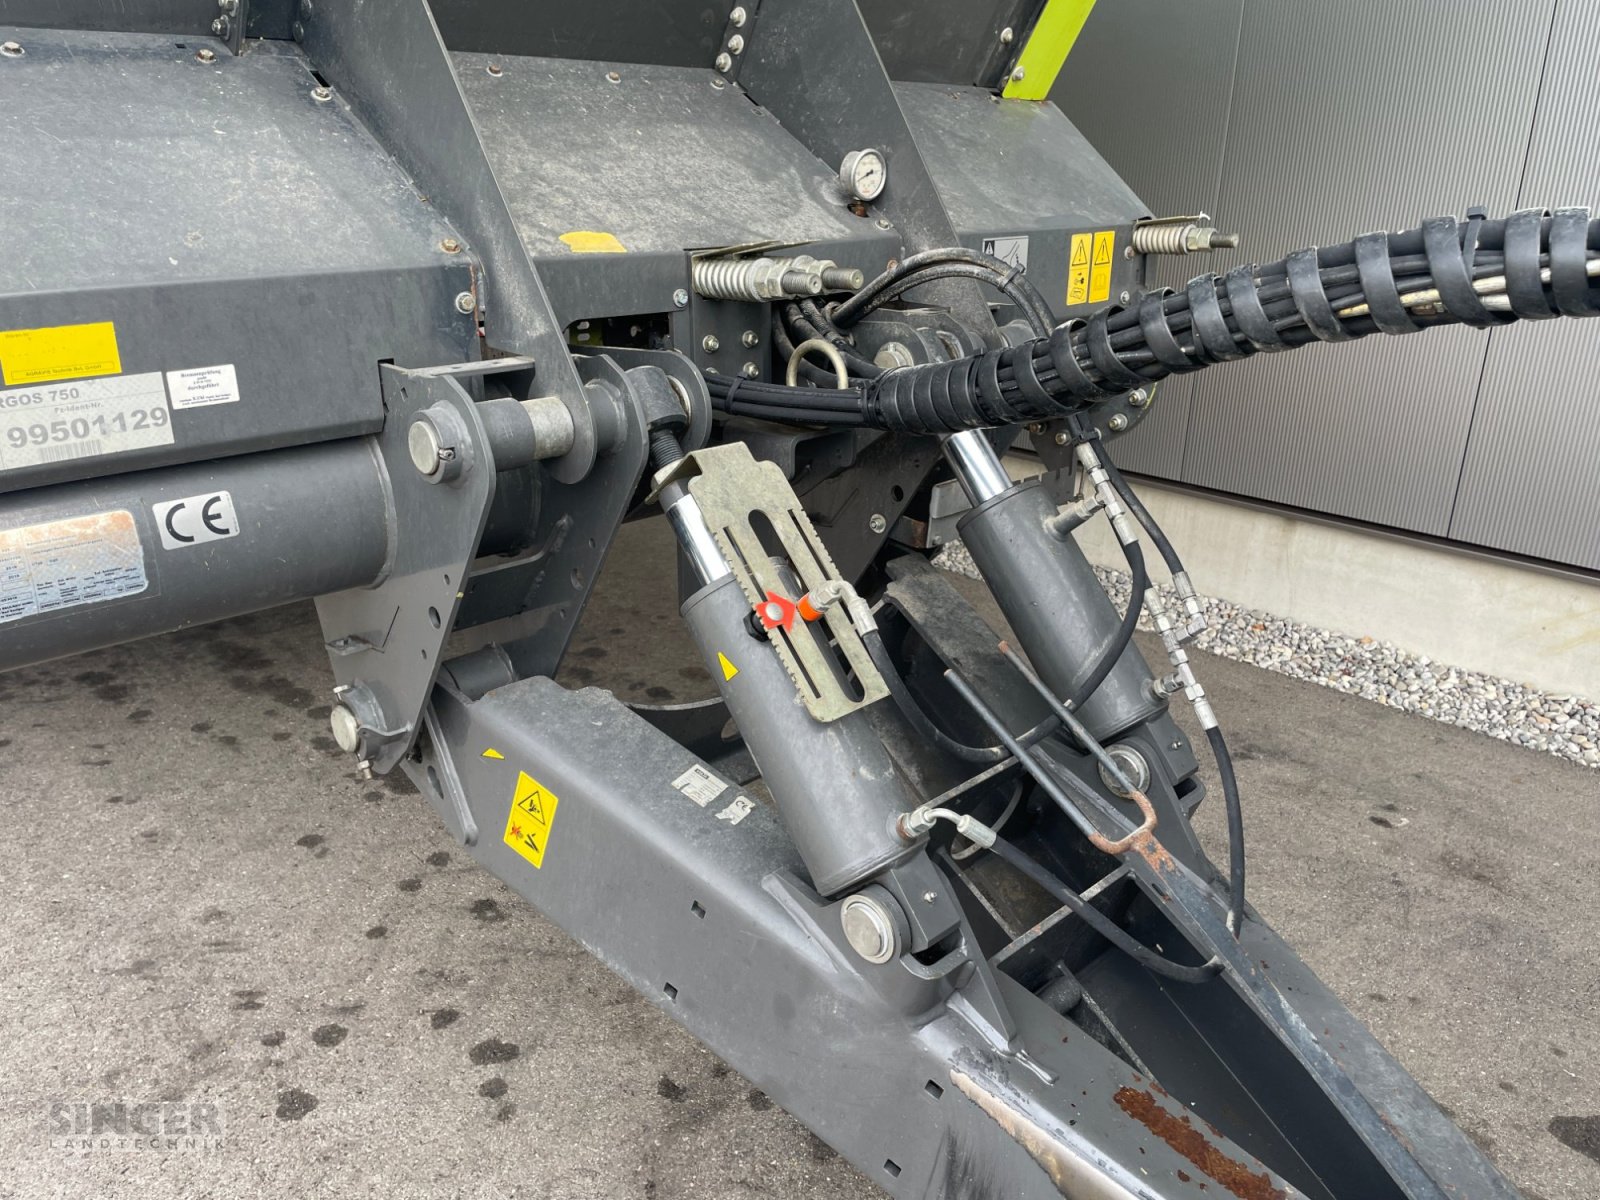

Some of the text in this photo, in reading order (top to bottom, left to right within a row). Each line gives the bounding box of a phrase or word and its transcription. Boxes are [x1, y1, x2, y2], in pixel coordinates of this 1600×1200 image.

[48, 387, 80, 402] 750
[7, 407, 168, 449] 99501129
[165, 496, 230, 543] CE
